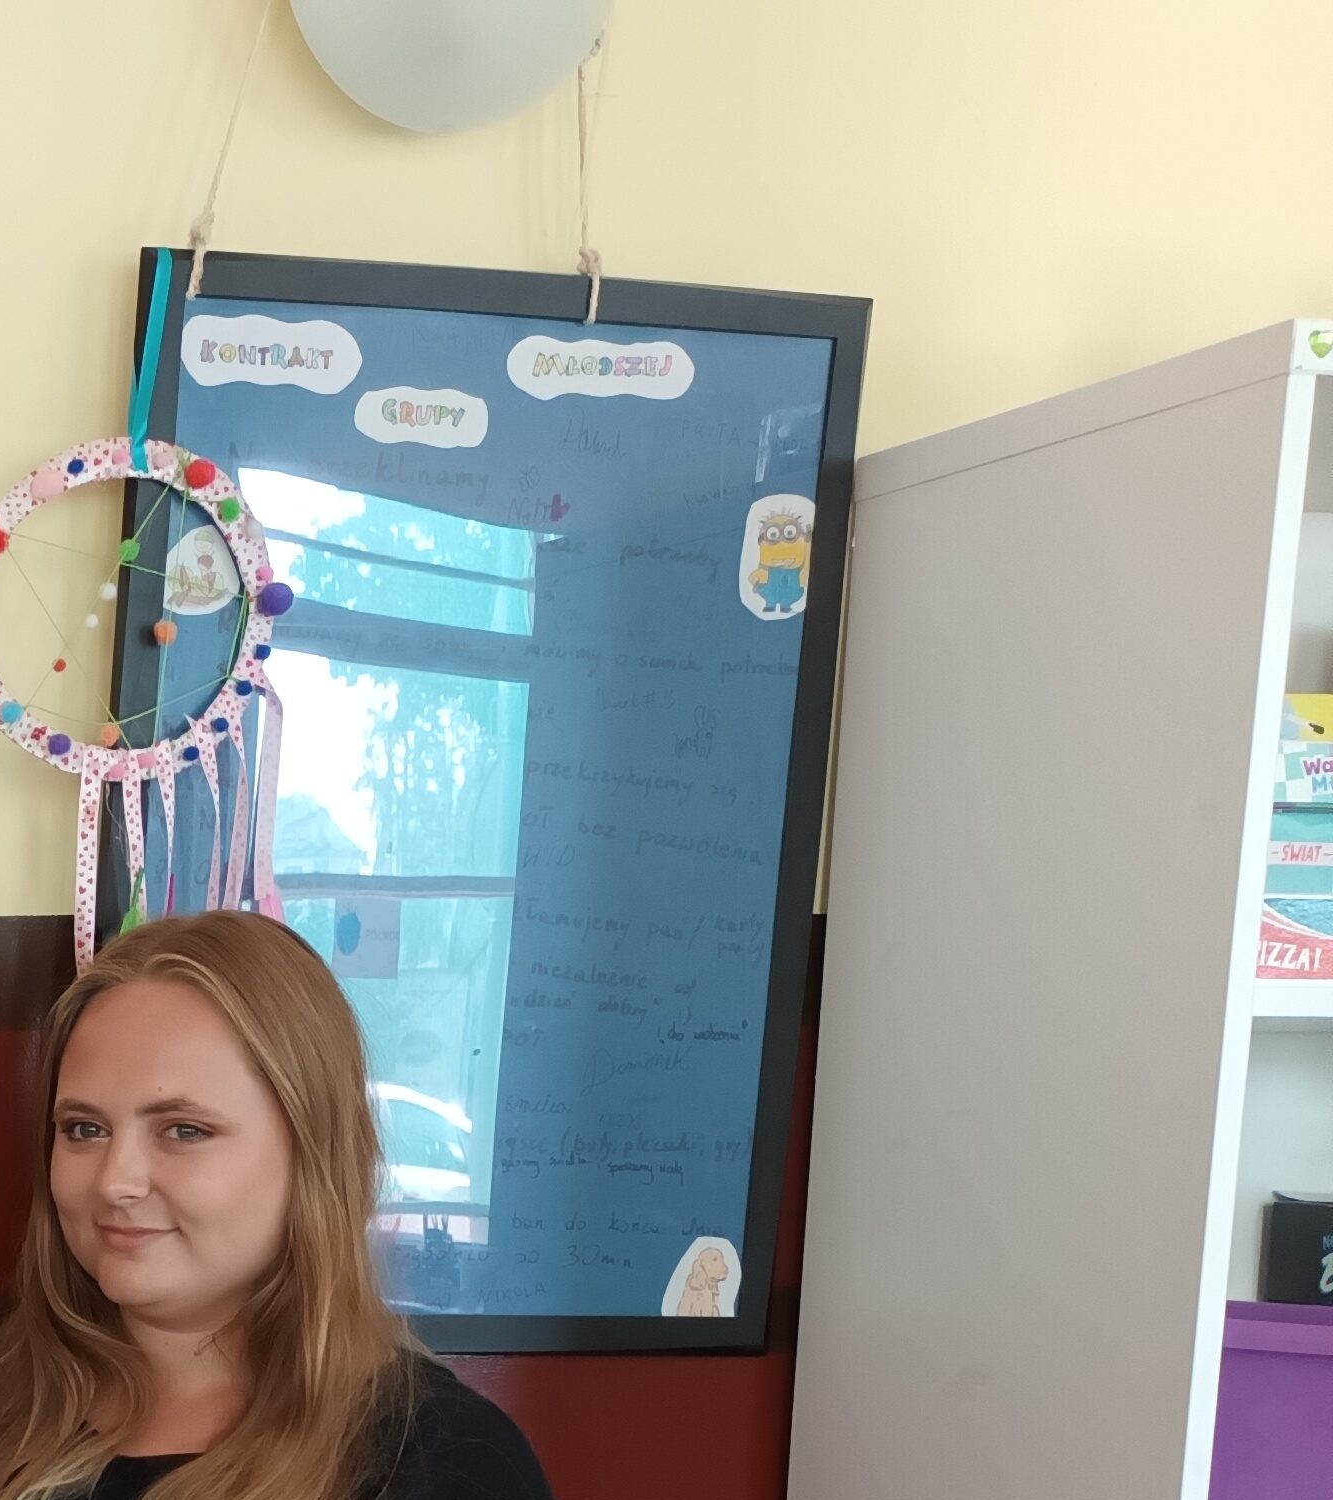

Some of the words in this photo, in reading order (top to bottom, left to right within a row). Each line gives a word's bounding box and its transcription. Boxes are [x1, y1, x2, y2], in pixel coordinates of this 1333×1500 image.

[200, 338, 334, 372] KONTRAKT
[531, 349, 674, 380] MŁODSZEJ
[380, 397, 467, 430] GRUPY
[1281, 841, 1322, 862] ŚWIAT
